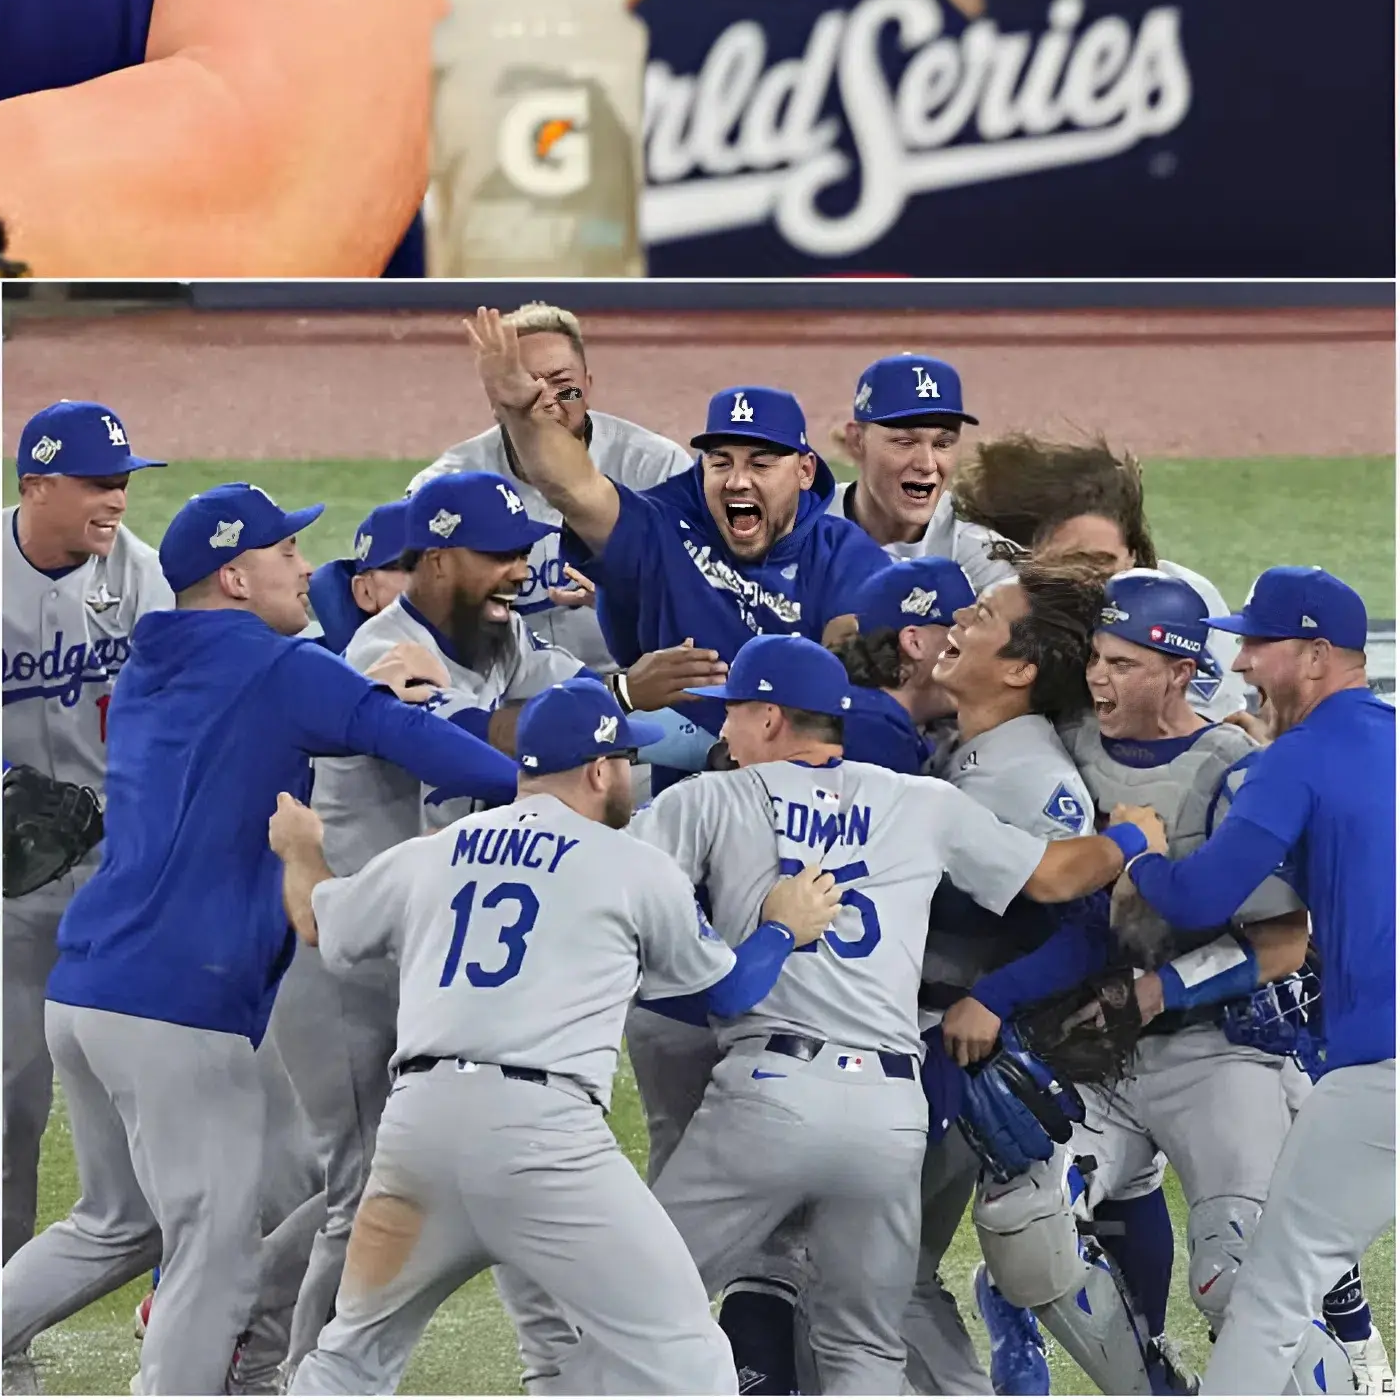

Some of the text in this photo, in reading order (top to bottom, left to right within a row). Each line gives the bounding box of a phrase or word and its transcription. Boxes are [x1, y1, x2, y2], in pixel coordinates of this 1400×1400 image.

[500, 86, 590, 197] G
[642, 8, 846, 184] rld
[912, 367, 941, 398] LA
[451, 828, 580, 873] MUNCY
[439, 880, 540, 988] 13
